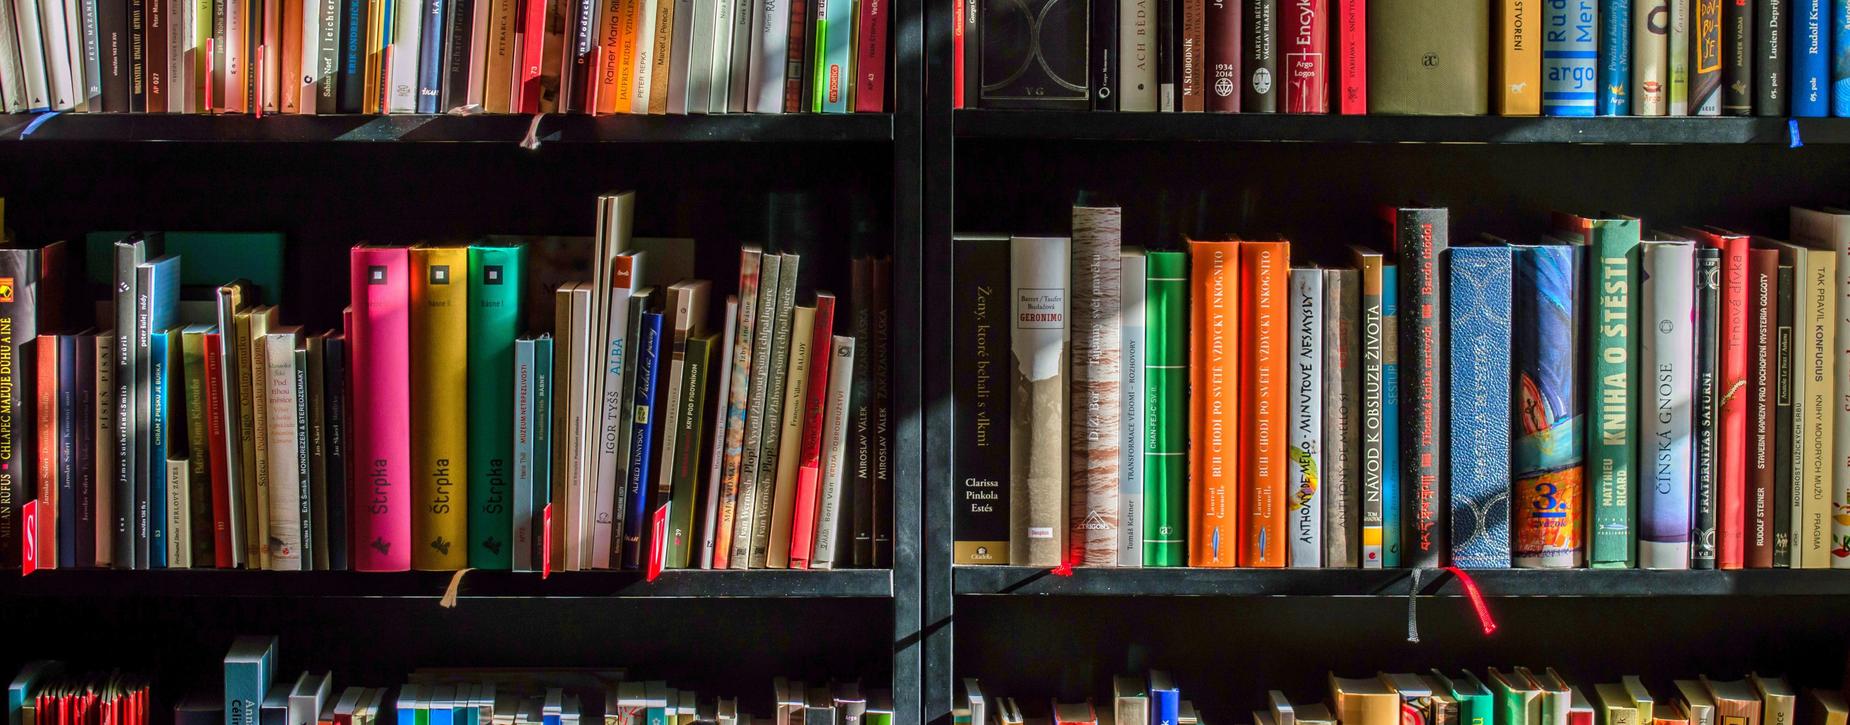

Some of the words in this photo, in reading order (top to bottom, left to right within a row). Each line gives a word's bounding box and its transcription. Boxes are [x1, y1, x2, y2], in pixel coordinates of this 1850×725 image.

[606, 16, 619, 47] Maria
[1254, 22, 1262, 34] EVA
[1262, 4, 1270, 30] BLAŽEK
[499, 16, 508, 57] PETRARCA
[1769, 30, 1778, 60] Lucien
[1809, 22, 1818, 54] Rudolf
[604, 50, 616, 85] Rainer
[639, 51, 647, 73] REPKA
[1136, 42, 1146, 70] ACH
[1183, 38, 1193, 84] SLOBODNÍK
[637, 76, 645, 98] PETER
[1294, 70, 1316, 78] Logos
[1549, 67, 1594, 88] argo
[1184, 85, 1192, 96] M.
[1090, 254, 1102, 296] pravěku
[1213, 250, 1224, 308] INKOGNITO
[1259, 250, 1270, 308] INKOGNITO
[1422, 262, 1432, 295] Bardo
[1728, 255, 1742, 294] dívka
[1817, 266, 1825, 286] TAK
[1600, 256, 1628, 337] ŠTĚSTÍ
[1816, 288, 1824, 321] PRAVIL
[1020, 312, 1063, 322] GERONIMO
[1300, 292, 1314, 358] NESMYSLY
[1364, 305, 1379, 358] ŽIVOTA
[1, 336, 10, 344] A
[140, 330, 148, 347] peter
[977, 324, 991, 356] ktoré
[1088, 322, 1102, 366] Tajemný
[1814, 324, 1824, 382] KONFUCIUS
[610, 338, 623, 376] ALBA
[797, 342, 806, 371] BALADY
[1604, 346, 1626, 364] O
[1758, 345, 1766, 386] POCHOPENÍ
[977, 358, 991, 398] behali
[1658, 362, 1672, 424] GNOSE
[606, 390, 618, 420] TYŠŠ
[1213, 401, 1222, 415] PO
[1259, 401, 1269, 415] PO
[1366, 364, 1379, 429] OBSLUZE
[1604, 373, 1626, 446] KNIHA
[1700, 372, 1712, 426] SATURNI
[1758, 386, 1766, 402] PRO
[100, 390, 110, 430] PÍSEŇ
[120, 384, 129, 456] Sutherland-Smith
[856, 412, 867, 438] VÁLEK
[1338, 406, 1348, 443] MELLO
[1758, 402, 1766, 433] KAMENY
[0, 414, 10, 460] CHLAPEC
[606, 426, 616, 455] IGOR
[877, 413, 886, 440] VÁLEK
[977, 410, 991, 446] vlkmi
[1367, 432, 1379, 442] K
[634, 428, 644, 466] TENNYSON
[744, 448, 757, 474] Plop!
[762, 447, 775, 474] Plop!
[1339, 448, 1348, 462] DE
[1656, 430, 1672, 494] ČÍNSKÁ
[120, 458, 128, 482] James
[858, 441, 868, 485] MIROSLAV
[878, 442, 887, 486] MIROSLAV
[1364, 446, 1379, 502] NÁVOD
[1699, 430, 1710, 514] FRATERNITAS
[370, 458, 390, 514] Štrpka
[428, 458, 452, 514] Štrpka
[632, 466, 641, 494] ALFRED
[966, 478, 998, 488] Clarissa
[966, 491, 998, 500] Pinkola
[1603, 458, 1612, 506] MATTHIEU
[1616, 470, 1626, 506] RICARD
[740, 480, 752, 519] Wernisch
[758, 478, 771, 518] Wernisch
[826, 488, 834, 504] Vian
[972, 504, 993, 512] Estés
[1206, 488, 1215, 516] Laurent
[1253, 488, 1261, 516] Laurent
[1756, 488, 1765, 518] STEINER
[738, 524, 748, 539] Ivan
[756, 523, 766, 538] Ivan
[824, 508, 832, 528] Boris
[1756, 518, 1764, 546] RUDOLF
[1813, 513, 1821, 550] PRAGMA
[1126, 528, 1134, 550] Tomáš
